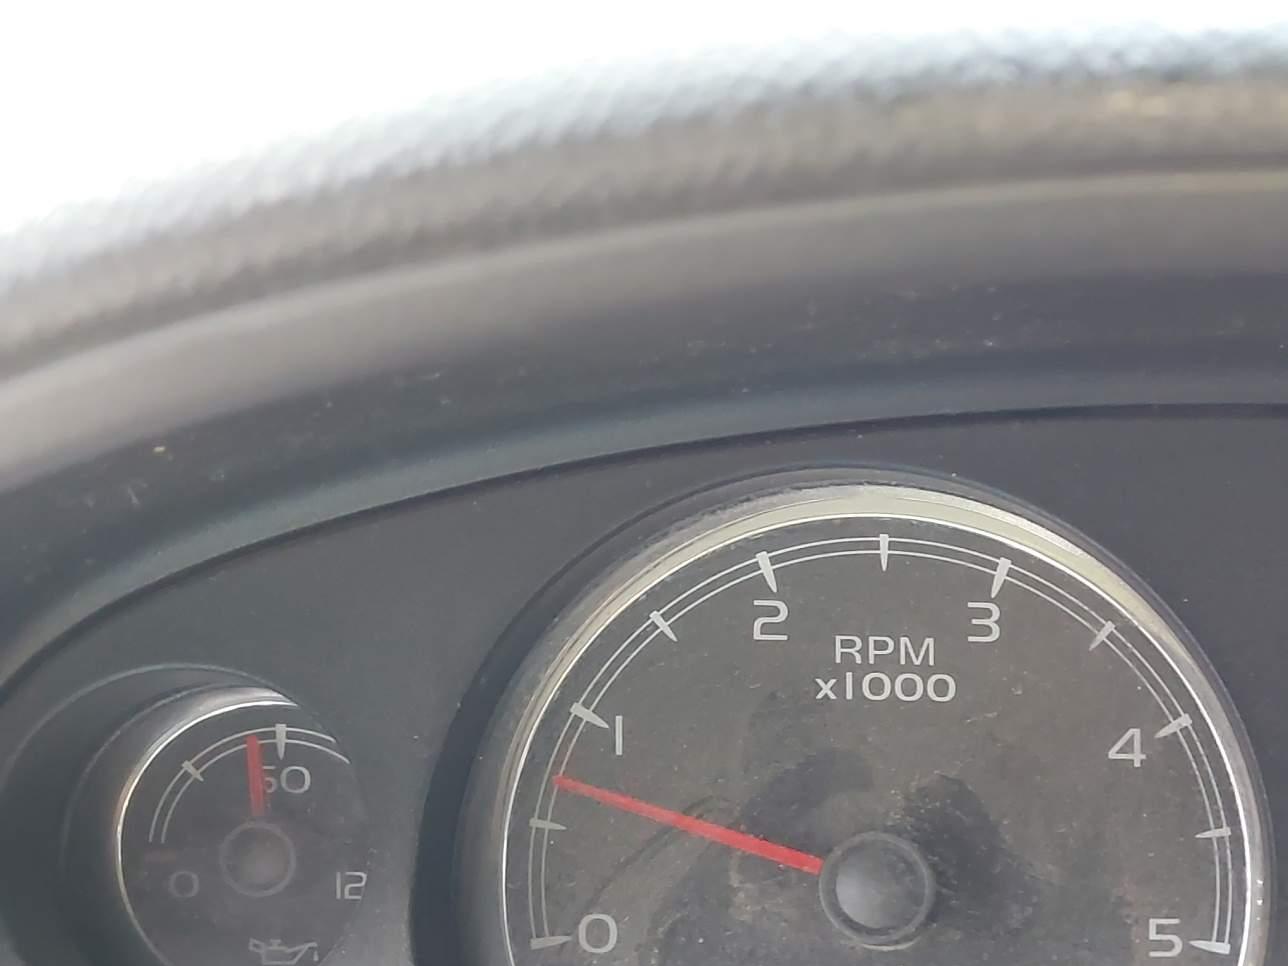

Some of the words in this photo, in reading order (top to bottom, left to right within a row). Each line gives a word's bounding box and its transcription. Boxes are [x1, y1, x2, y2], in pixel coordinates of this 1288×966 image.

[753, 600, 789, 641] 2
[967, 601, 1001, 643] 3
[834, 635, 936, 666] RPM
[815, 671, 957, 703] x1000
[615, 715, 623, 756] 1
[1107, 727, 1147, 768] 4
[168, 870, 200, 898] 0
[578, 913, 618, 954] 0
[1147, 917, 1183, 958] 5
